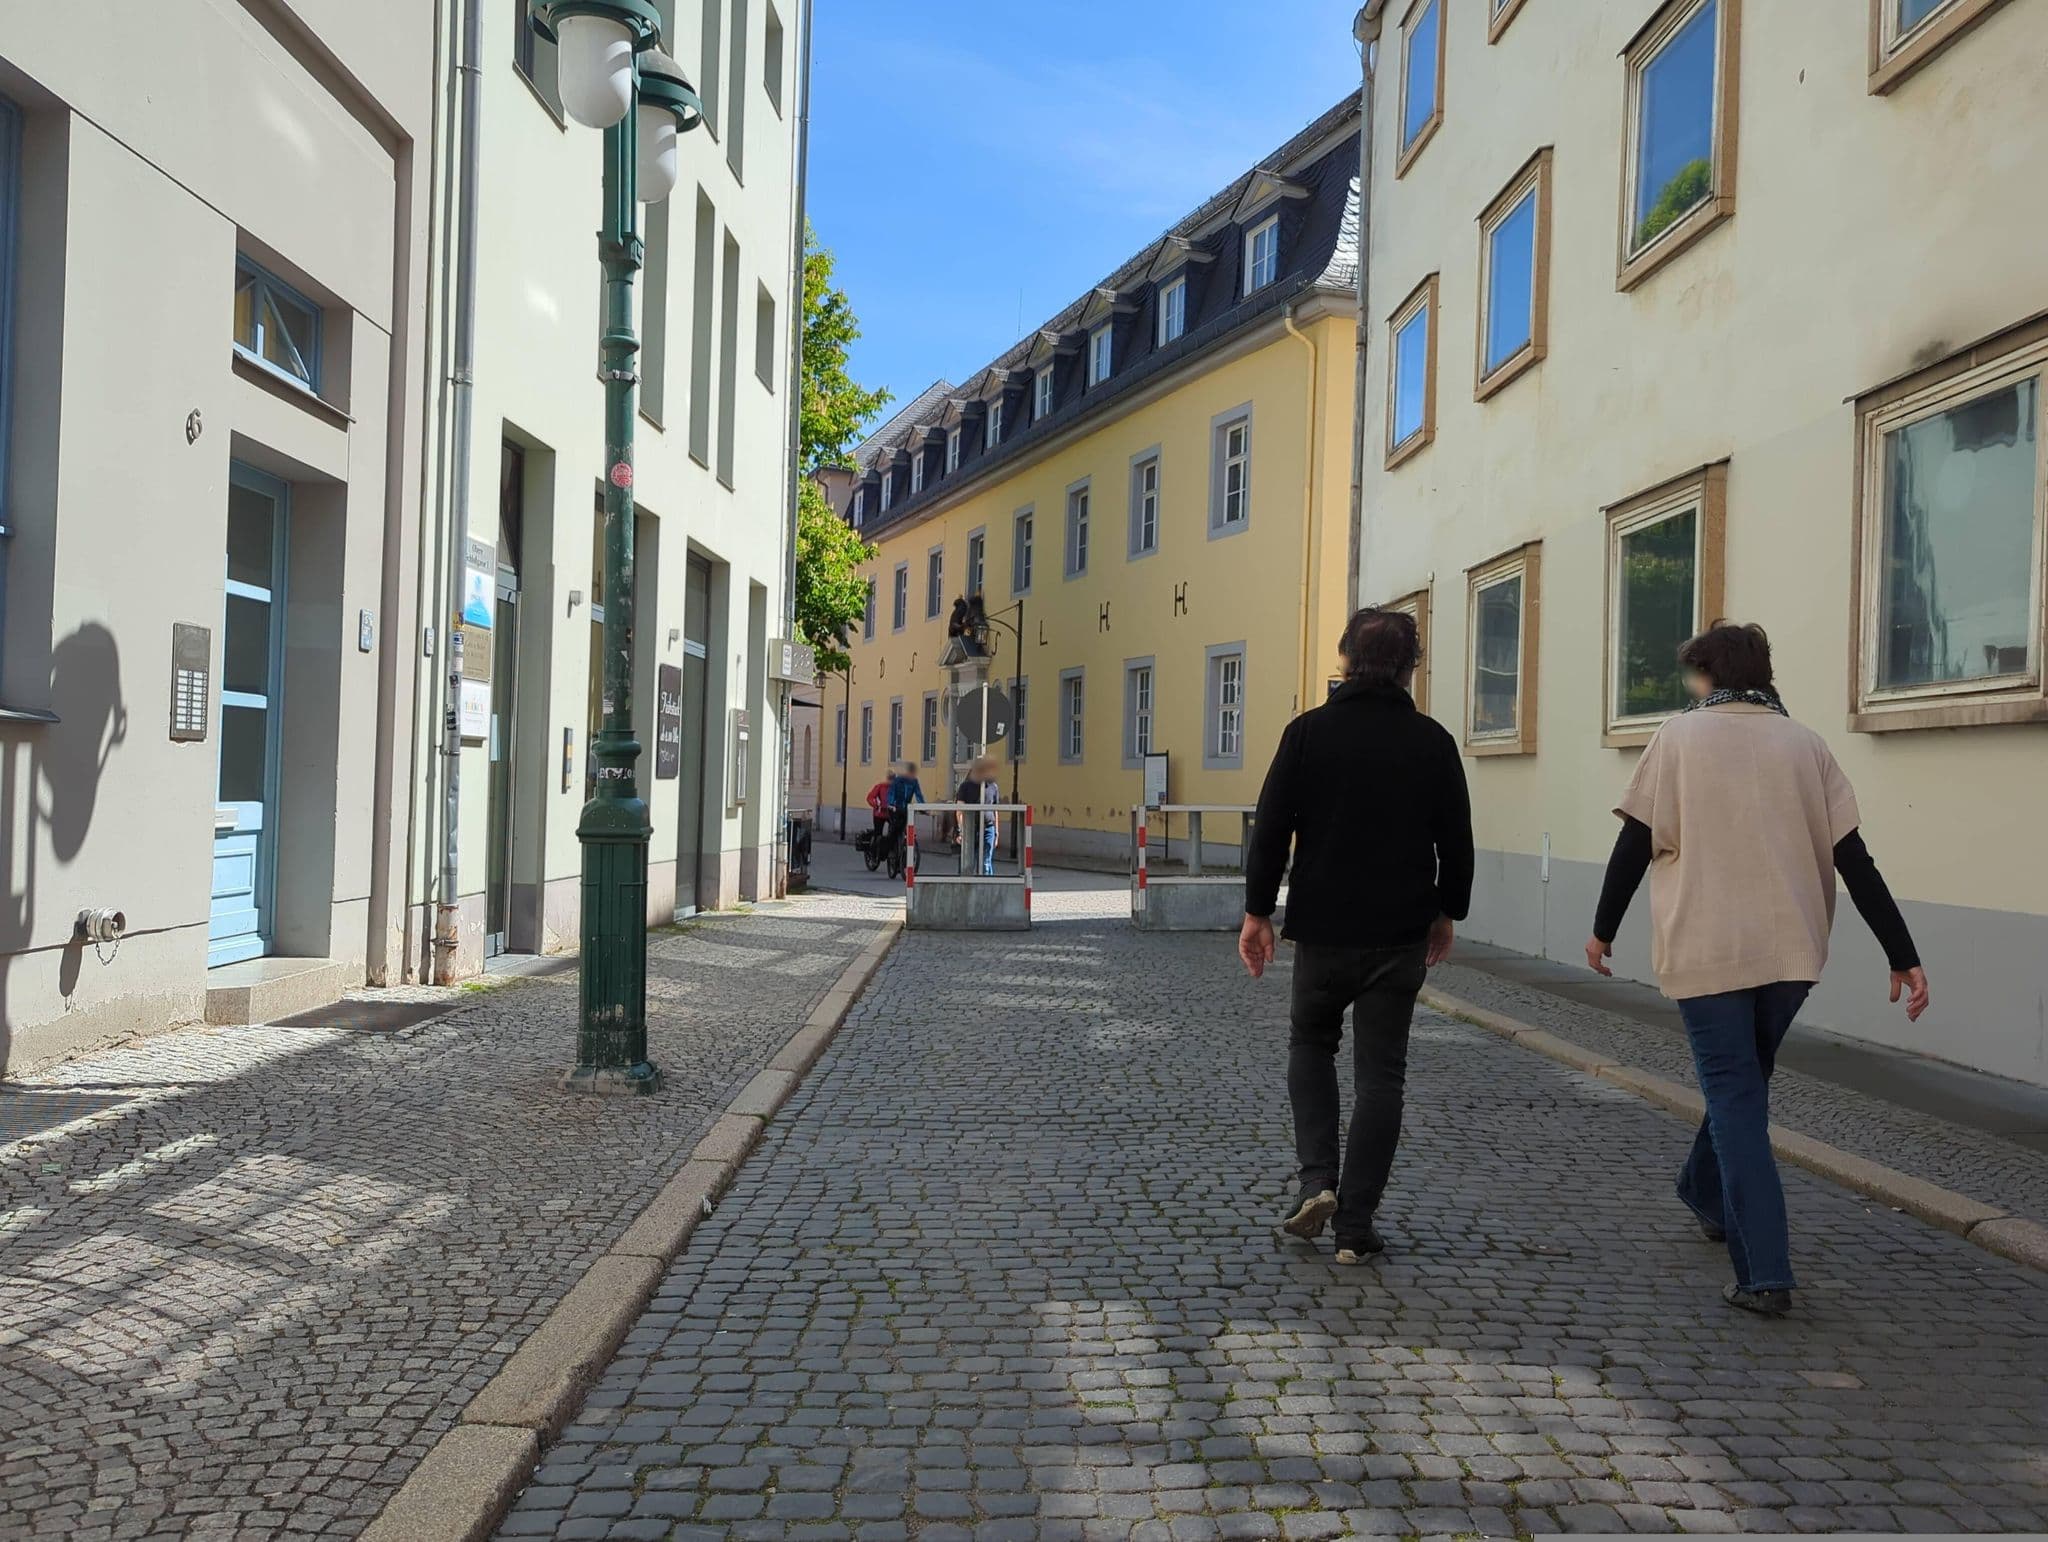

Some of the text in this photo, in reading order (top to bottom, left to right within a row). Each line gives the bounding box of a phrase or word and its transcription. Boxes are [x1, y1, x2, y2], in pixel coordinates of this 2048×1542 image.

[190, 408, 203, 440] 6
[1039, 619, 1048, 646] L
[1099, 600, 1111, 633] H
[1174, 581, 1188, 618] H
